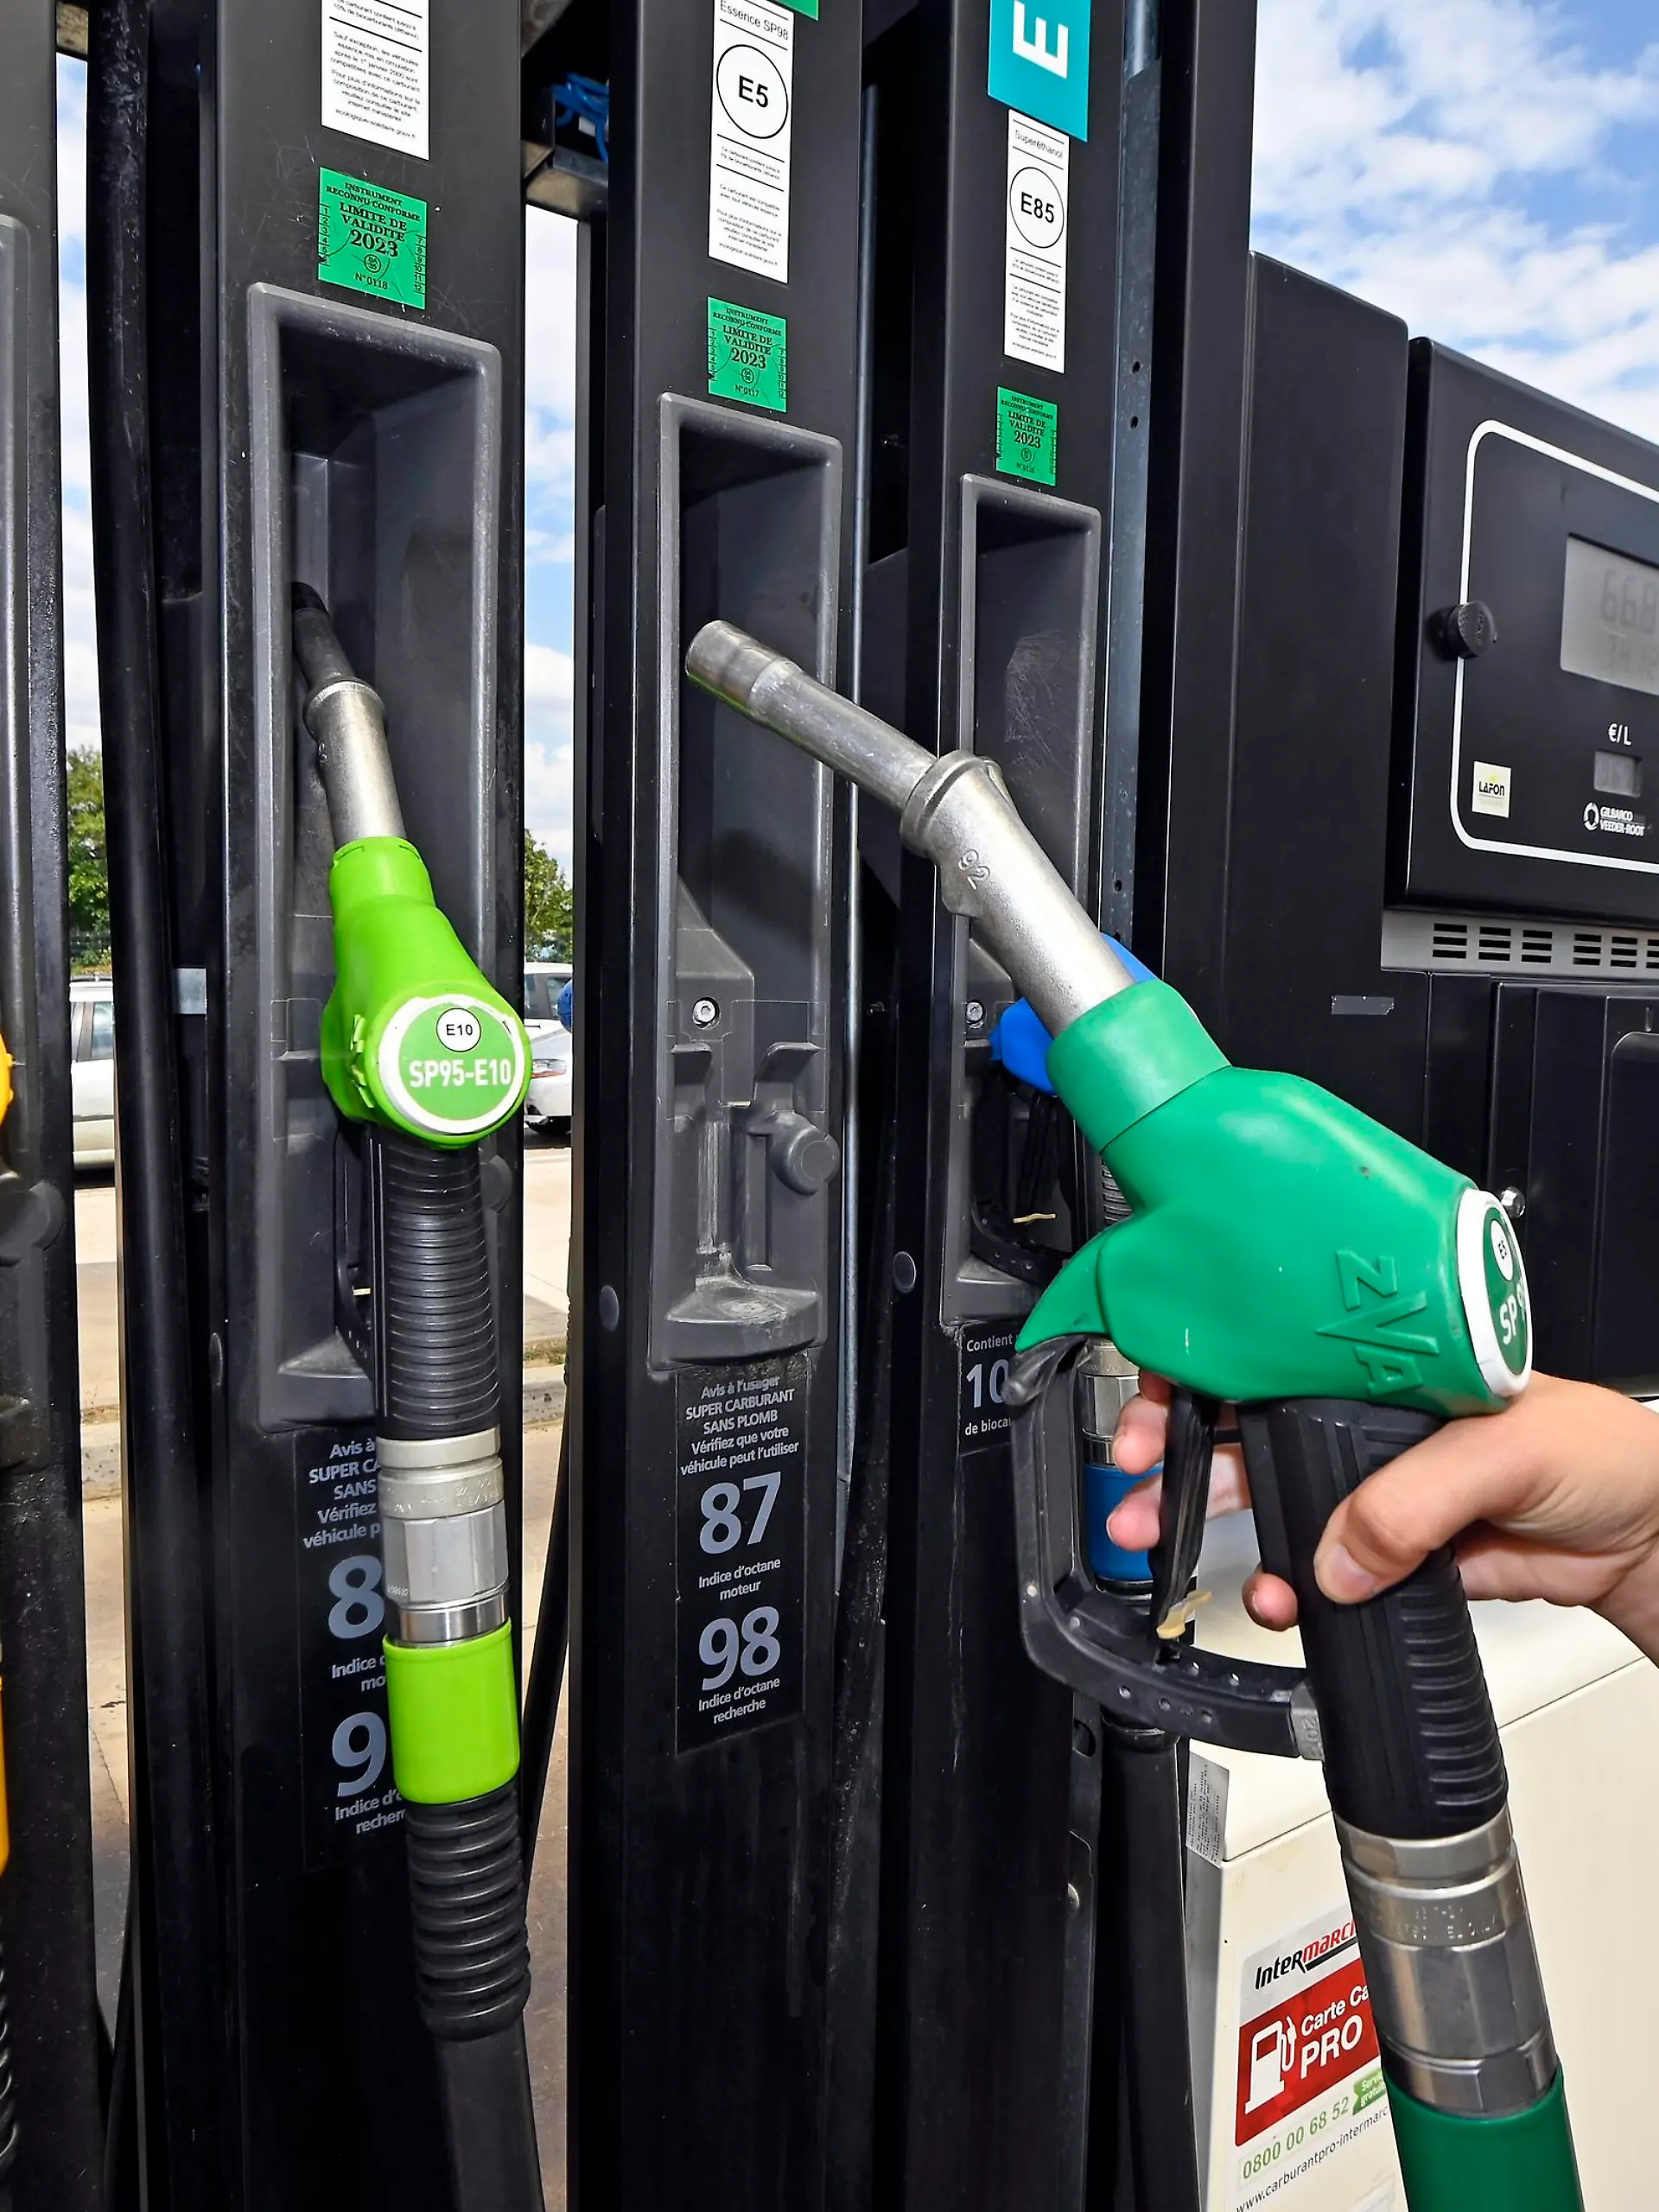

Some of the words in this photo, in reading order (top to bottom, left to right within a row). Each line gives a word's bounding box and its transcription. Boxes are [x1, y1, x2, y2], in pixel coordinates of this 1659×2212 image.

[720, 0, 760, 28] Essence
[764, 19, 789, 41] SP98
[1013, 0, 1068, 79] E
[739, 75, 768, 108] E5
[326, 186, 370, 205] RECONNU
[372, 200, 420, 221] CONFORME
[346, 181, 403, 206] INSTRUMENT
[340, 201, 386, 225] LIMITE
[390, 218, 407, 231] DE
[1021, 191, 1054, 224] E85
[341, 214, 405, 242] VALIDITE
[351, 230, 397, 257] 2023
[727, 308, 768, 324] INSTRUMENT
[723, 325, 757, 340] LIMITE
[760, 336, 772, 345] DE
[725, 335, 772, 355] VALIDITE
[731, 347, 766, 369] 2023
[1014, 430, 1040, 448] 2023
[1608, 723, 1632, 746] €/L
[446, 1024, 474, 1036] E10
[409, 1058, 512, 1088] SP95-E10
[967, 1333, 1013, 1352] Contient
[701, 1383, 725, 1400] Avis
[727, 1382, 734, 1395] à
[966, 1359, 1009, 1408] 10
[686, 1402, 722, 1420] SUPER
[725, 1389, 795, 1414] CARBURANT
[703, 1418, 734, 1435] SANS
[737, 1409, 778, 1429] PLOMB
[965, 1422, 978, 1435] de
[329, 1442, 361, 1459] Avis
[366, 1438, 376, 1452] à
[691, 1437, 734, 1455] Vérifiez
[736, 1432, 758, 1449] que
[760, 1427, 789, 1441] votre
[681, 1455, 727, 1476] véhicule
[729, 1450, 755, 1469] peut
[758, 1441, 799, 1459] l'utiliser
[308, 1462, 359, 1484] SUPER
[334, 1478, 377, 1500] SANS
[318, 1503, 377, 1524] Vérifiez
[699, 1471, 781, 1554] 87
[303, 1524, 366, 1549] véhicule
[699, 1571, 732, 1588] Indice
[734, 1559, 781, 1580] d'octane
[328, 1555, 385, 1639] 8
[720, 1580, 760, 1600] moteur
[699, 1606, 780, 1691] 98
[332, 1658, 376, 1679] Indice
[698, 1693, 731, 1712] Indice
[734, 1677, 780, 1701] d'octane
[713, 1699, 766, 1725] recherche
[332, 1712, 386, 1797] 9
[335, 1796, 379, 1821] Indice
[1301, 1999, 1345, 2037] Carte
[1300, 2014, 1363, 2080] PRO
[1243, 2140, 1281, 2179] 0800
[1287, 2126, 1304, 2151] 00
[1310, 2111, 1326, 2135] 68
[1332, 2096, 1349, 2120] 52
